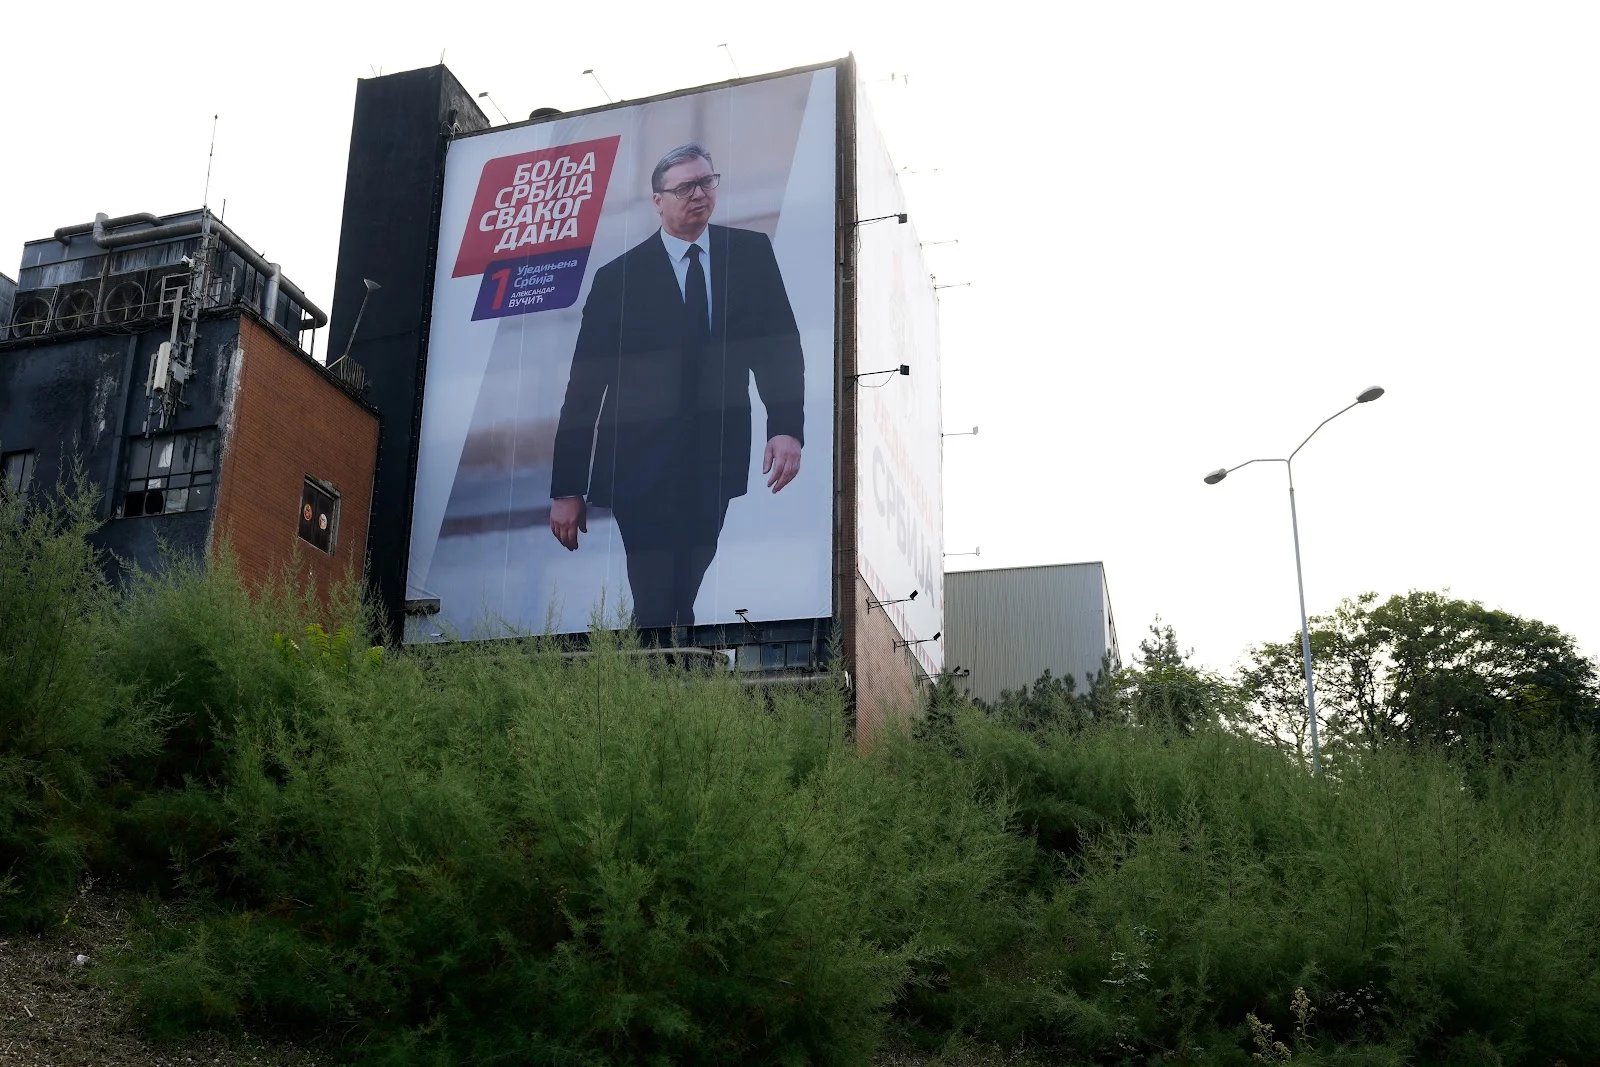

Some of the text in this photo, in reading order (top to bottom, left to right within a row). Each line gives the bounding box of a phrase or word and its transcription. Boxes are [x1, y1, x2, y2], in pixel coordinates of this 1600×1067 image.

[512, 151, 596, 186] БОЉА
[495, 173, 593, 209] СРБИЈА
[479, 194, 591, 232] СВАКОГ
[493, 217, 578, 253] ДАНА
[514, 274, 554, 288] Србија
[517, 259, 578, 276] Уједињена
[491, 268, 512, 310] 1
[508, 295, 544, 308] ВУЧИЋ
[511, 286, 556, 299] АЛЕКСАНДАР
